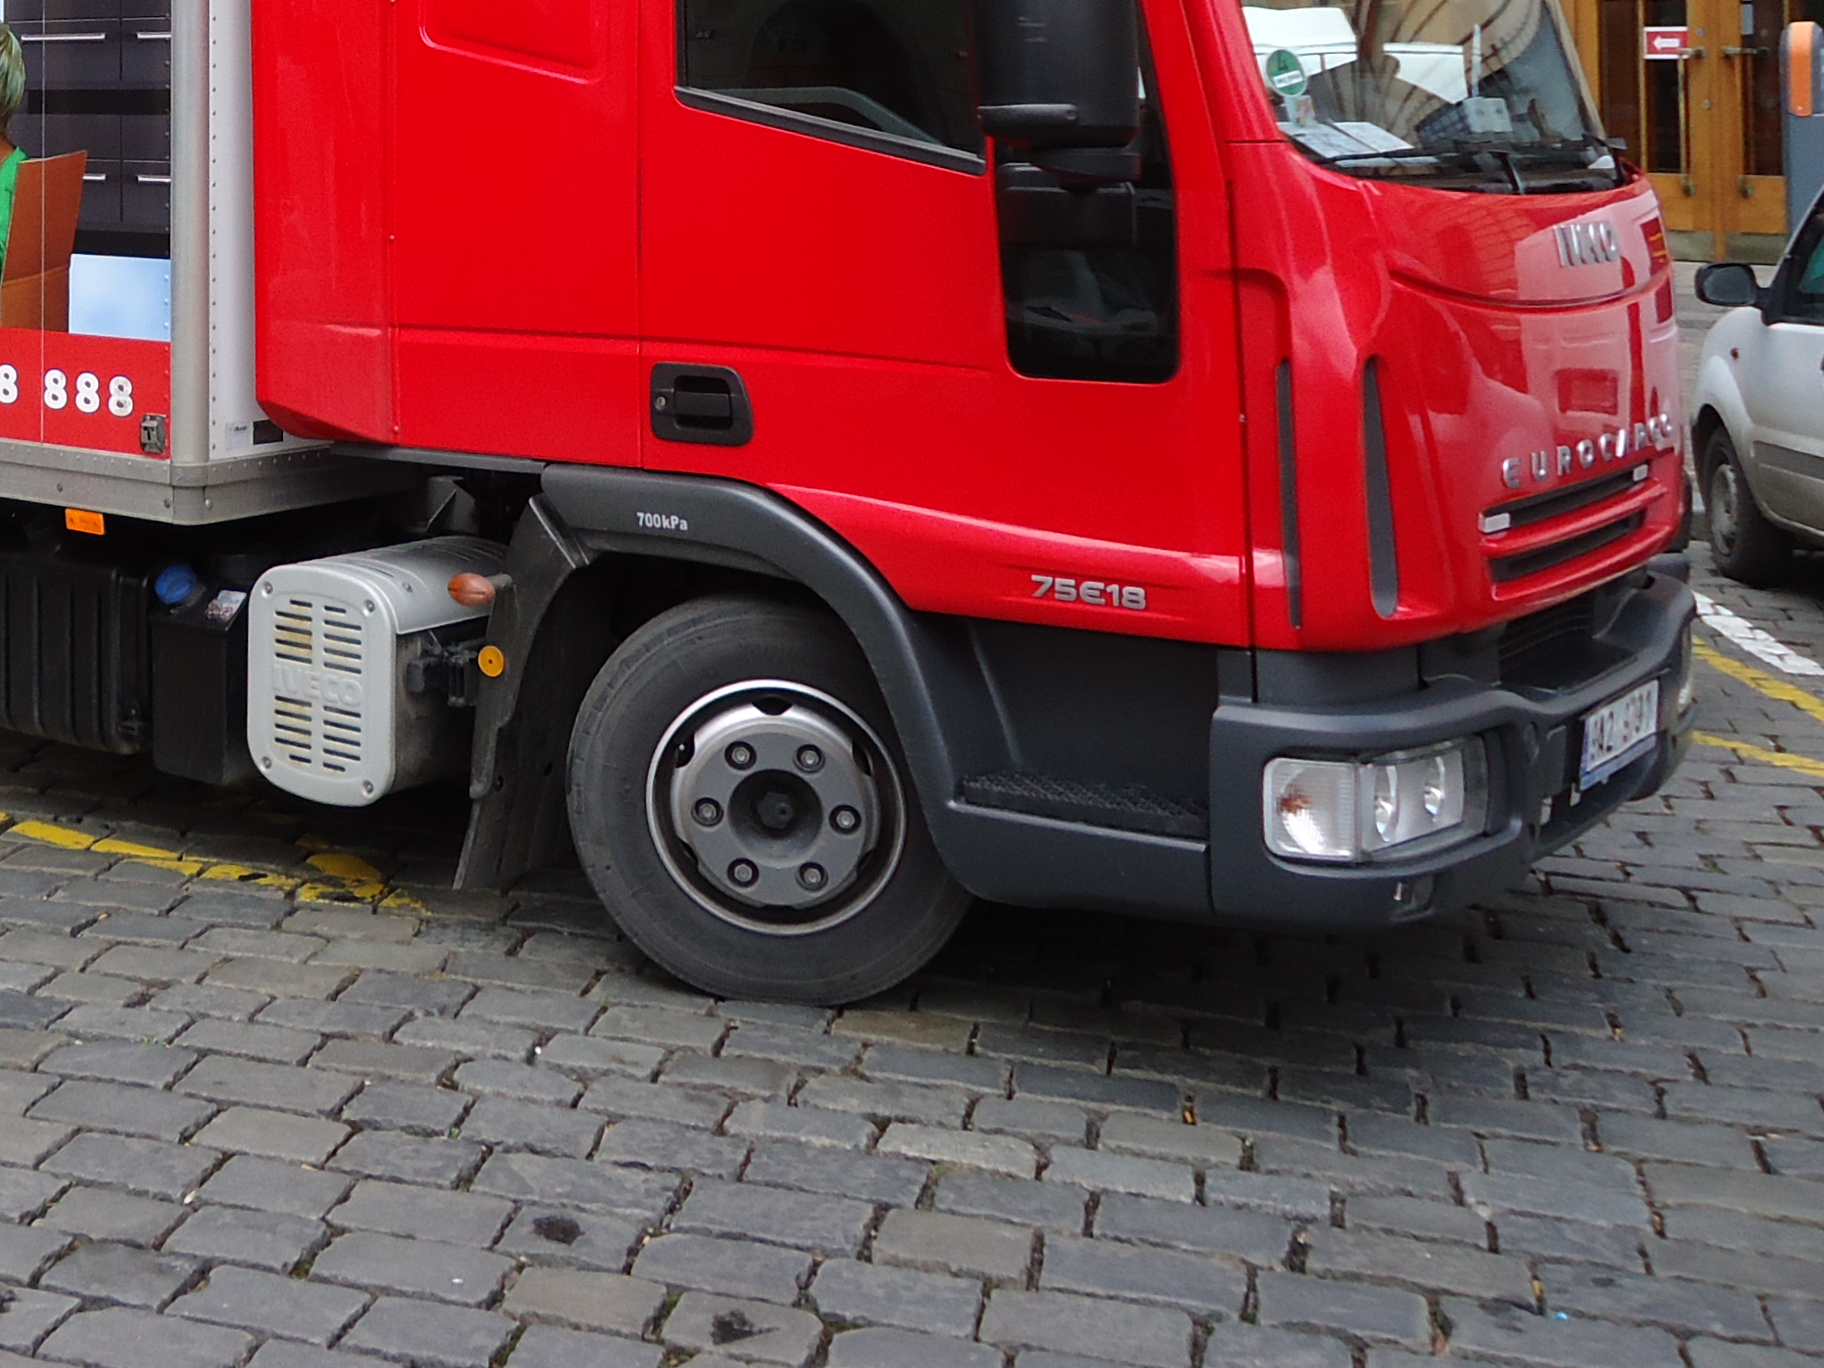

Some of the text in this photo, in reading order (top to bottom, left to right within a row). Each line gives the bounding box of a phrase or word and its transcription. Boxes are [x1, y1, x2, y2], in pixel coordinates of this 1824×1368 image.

[43, 368, 134, 417] 888
[636, 512, 688, 531] 700kPa
[1031, 574, 1147, 610] 75E18
[273, 664, 363, 708] IVECO
